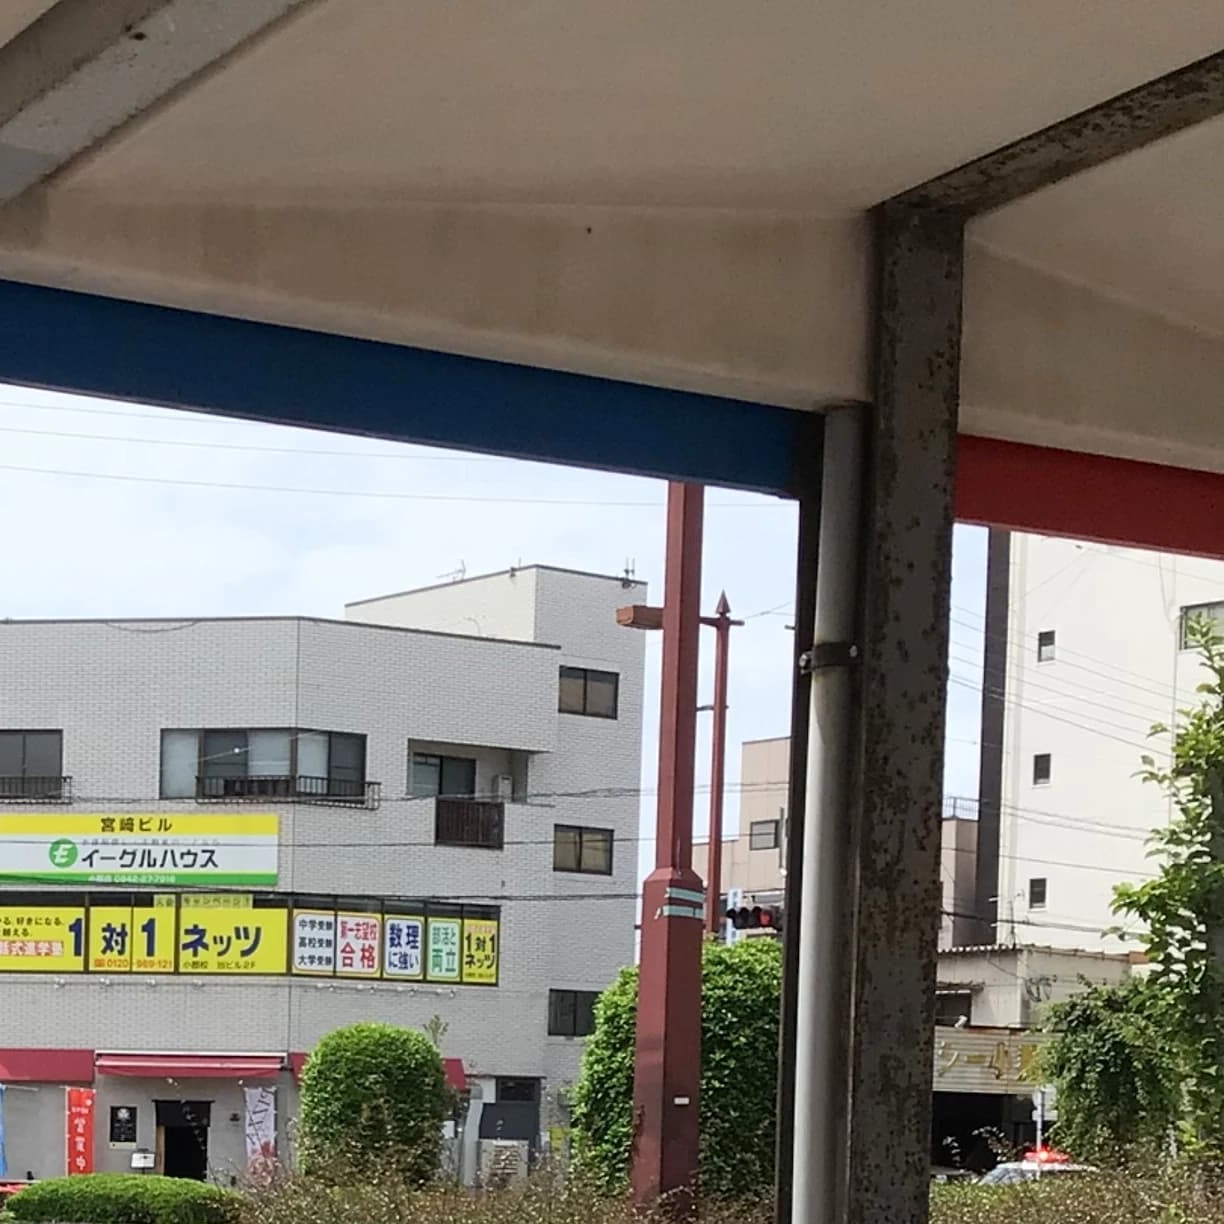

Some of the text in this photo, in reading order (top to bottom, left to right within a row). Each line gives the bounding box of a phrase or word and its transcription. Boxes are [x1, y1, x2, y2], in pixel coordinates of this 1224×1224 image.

[81, 848, 218, 868] イーグルハウス
[389, 923, 419, 949] 数理
[298, 954, 332, 966] 大学受験
[340, 942, 376, 969] 合格
[388, 952, 419, 970] に強い
[432, 948, 456, 972] 両立
